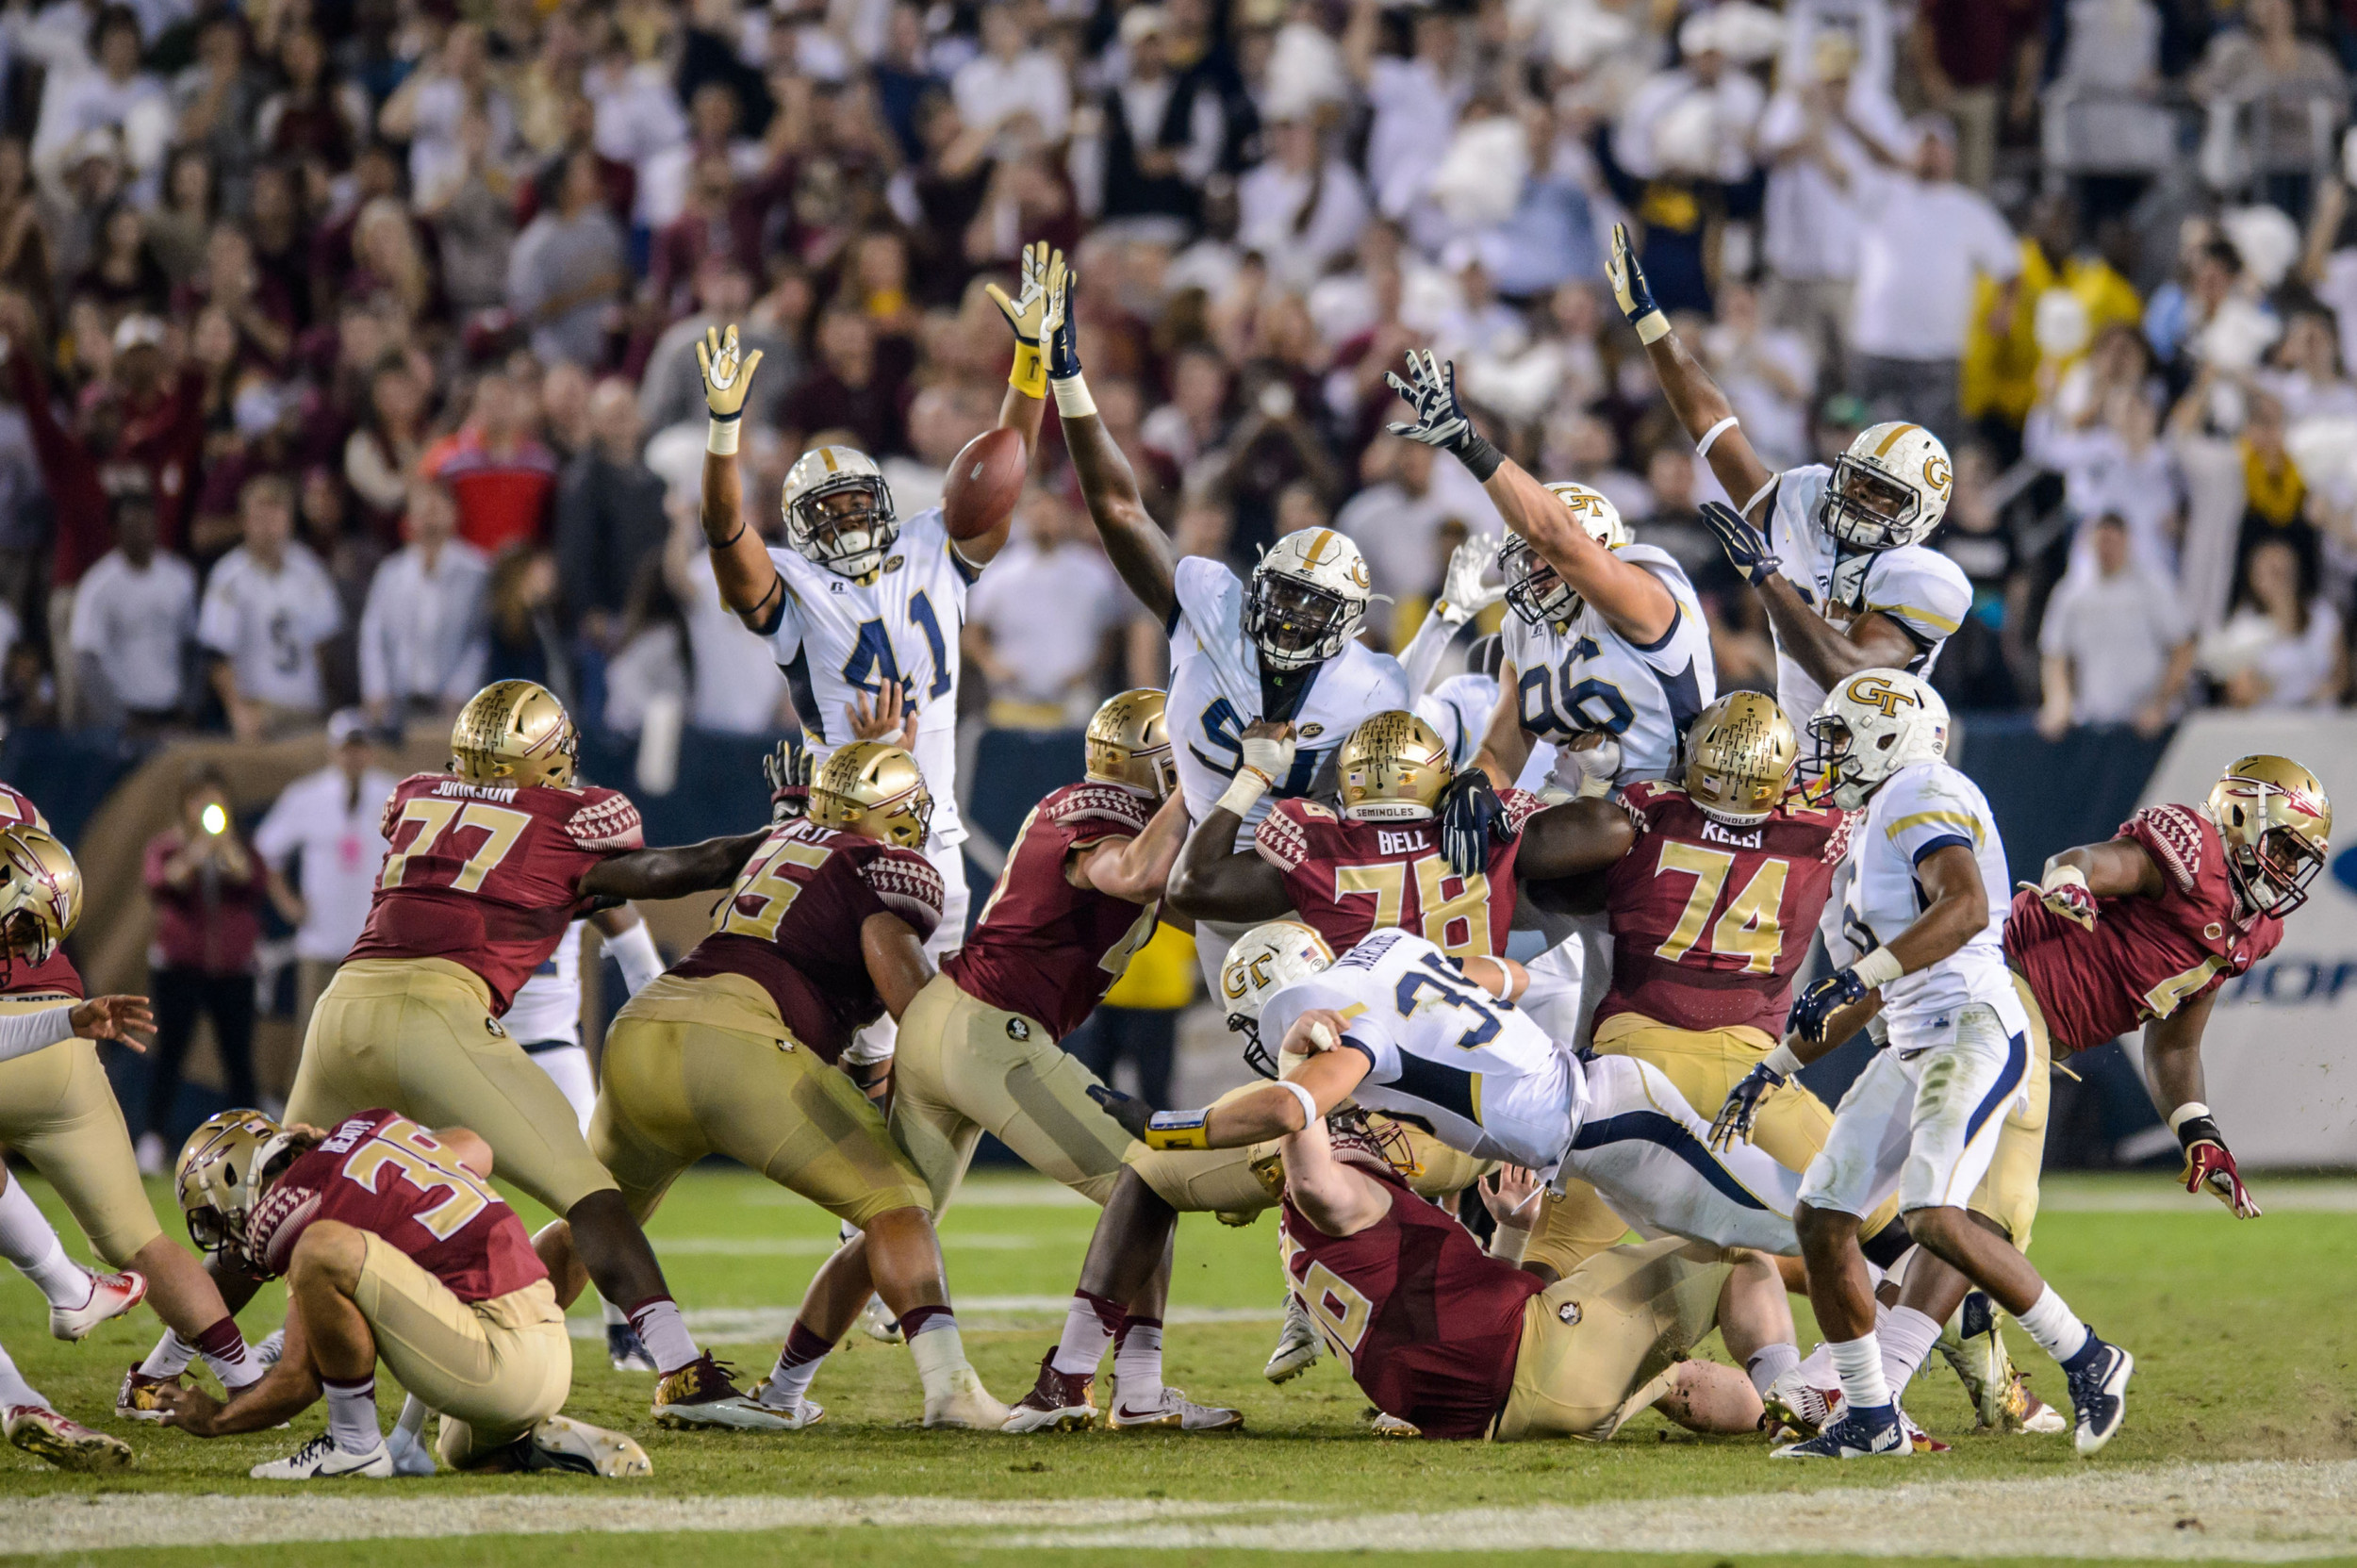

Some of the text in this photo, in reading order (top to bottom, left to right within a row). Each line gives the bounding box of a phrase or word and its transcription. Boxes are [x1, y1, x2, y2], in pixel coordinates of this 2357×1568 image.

[842, 586, 952, 717] 41
[1519, 634, 1637, 744] 96
[1846, 676, 1914, 718] GT
[1301, 725, 1322, 735] ACC
[1356, 808, 1414, 817] SEMINOLES
[382, 798, 534, 892] 77
[1377, 831, 1430, 855] BELL
[1701, 820, 1761, 850] KELLY
[1334, 852, 1492, 957] 78
[1654, 840, 1789, 975] 74
[1224, 952, 1273, 999] GT
[1871, 1423, 1899, 1454] NIKE
